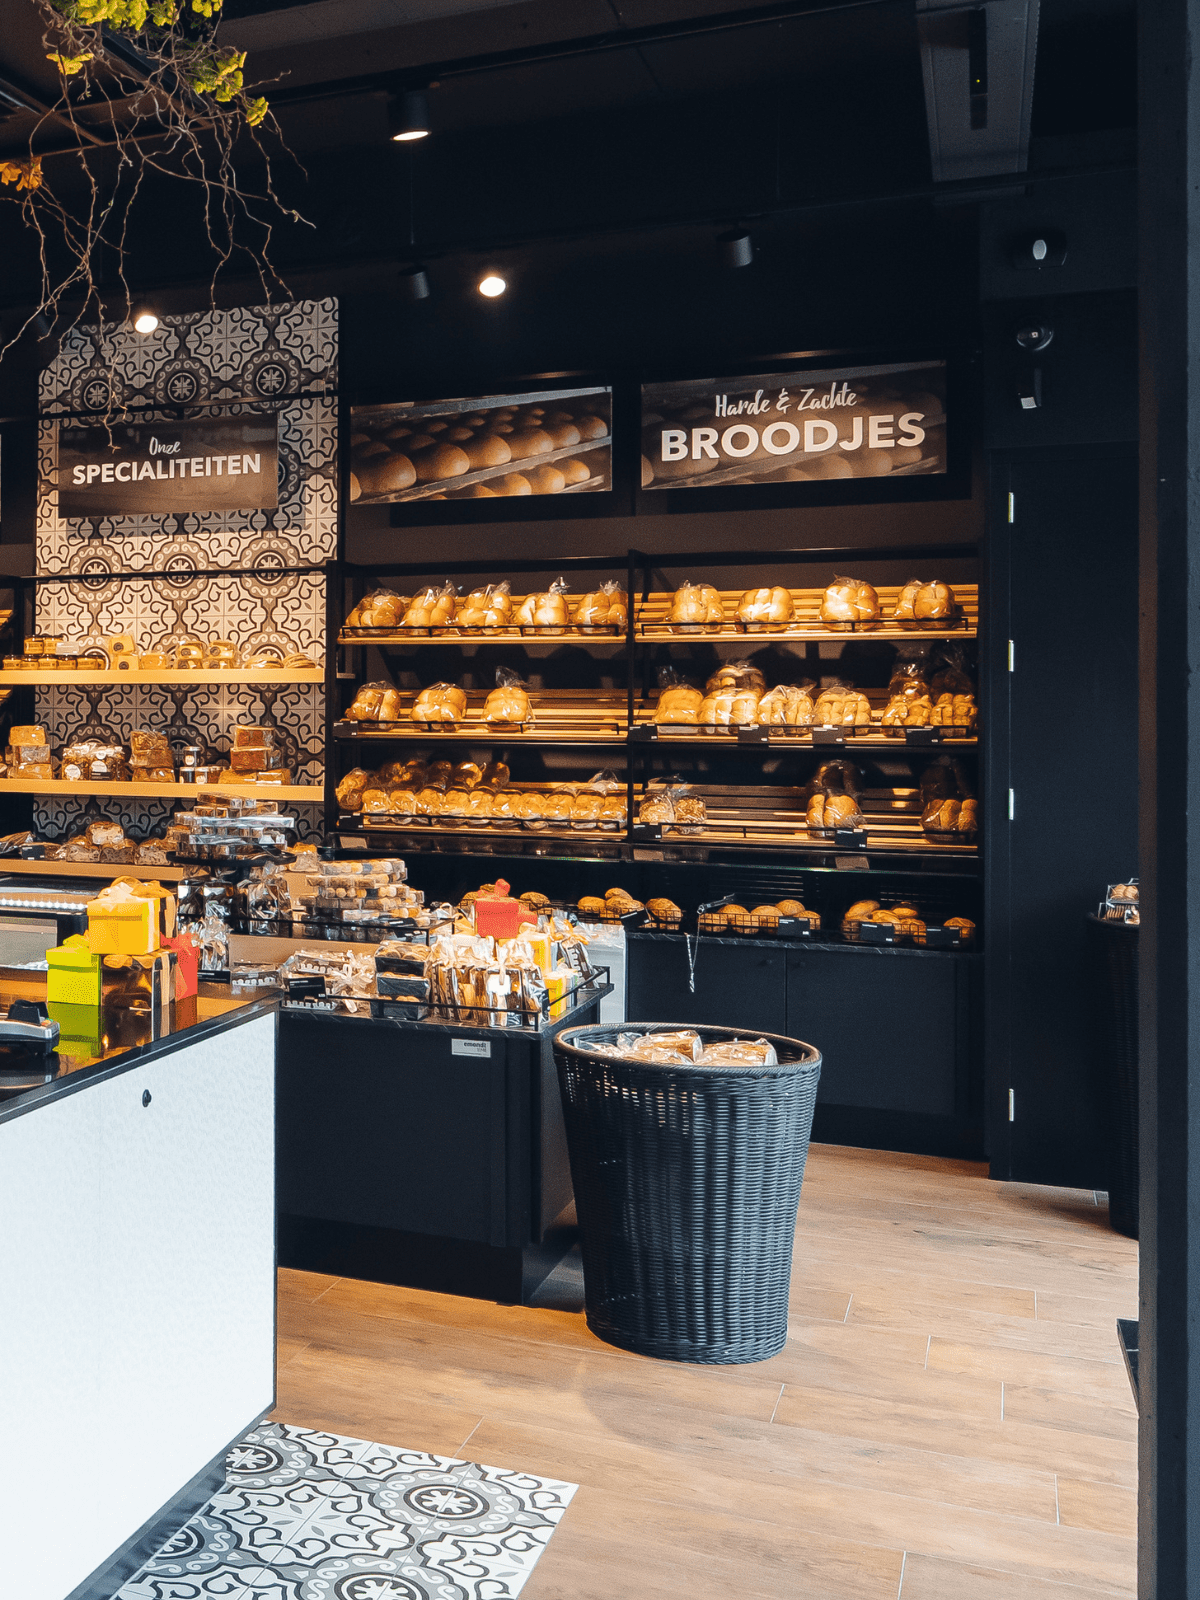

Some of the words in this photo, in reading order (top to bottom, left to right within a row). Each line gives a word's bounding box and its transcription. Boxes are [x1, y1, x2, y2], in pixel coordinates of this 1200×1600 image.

[715, 389, 771, 418] Harde
[775, 388, 792, 414] &
[797, 381, 857, 411] Zachte
[149, 436, 180, 456] Onze
[661, 412, 926, 462] BROODJES
[72, 453, 261, 485] SPECIALITEITEN
